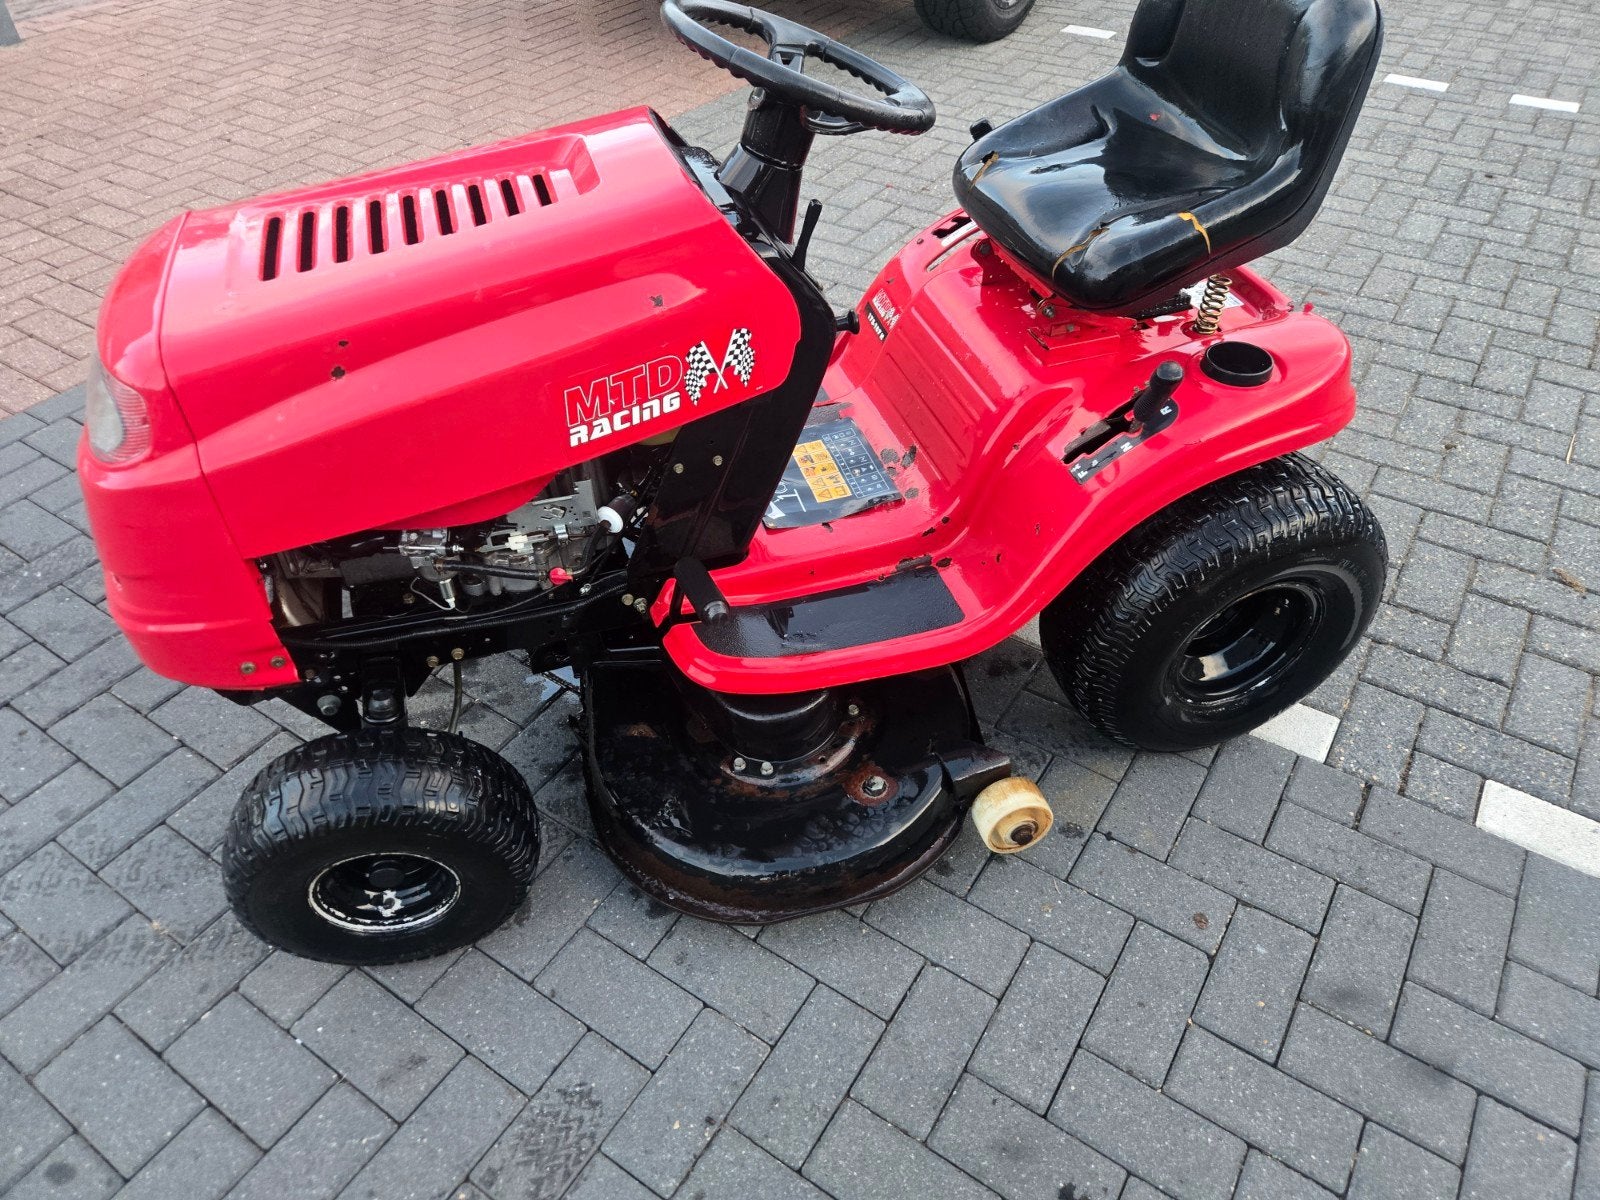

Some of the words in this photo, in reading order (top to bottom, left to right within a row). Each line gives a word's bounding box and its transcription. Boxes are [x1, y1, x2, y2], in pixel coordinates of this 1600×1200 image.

[563, 355, 683, 427] MTD
[1160, 405, 1172, 415] R
[1120, 442, 1133, 453] N
[1077, 469, 1088, 478] F
